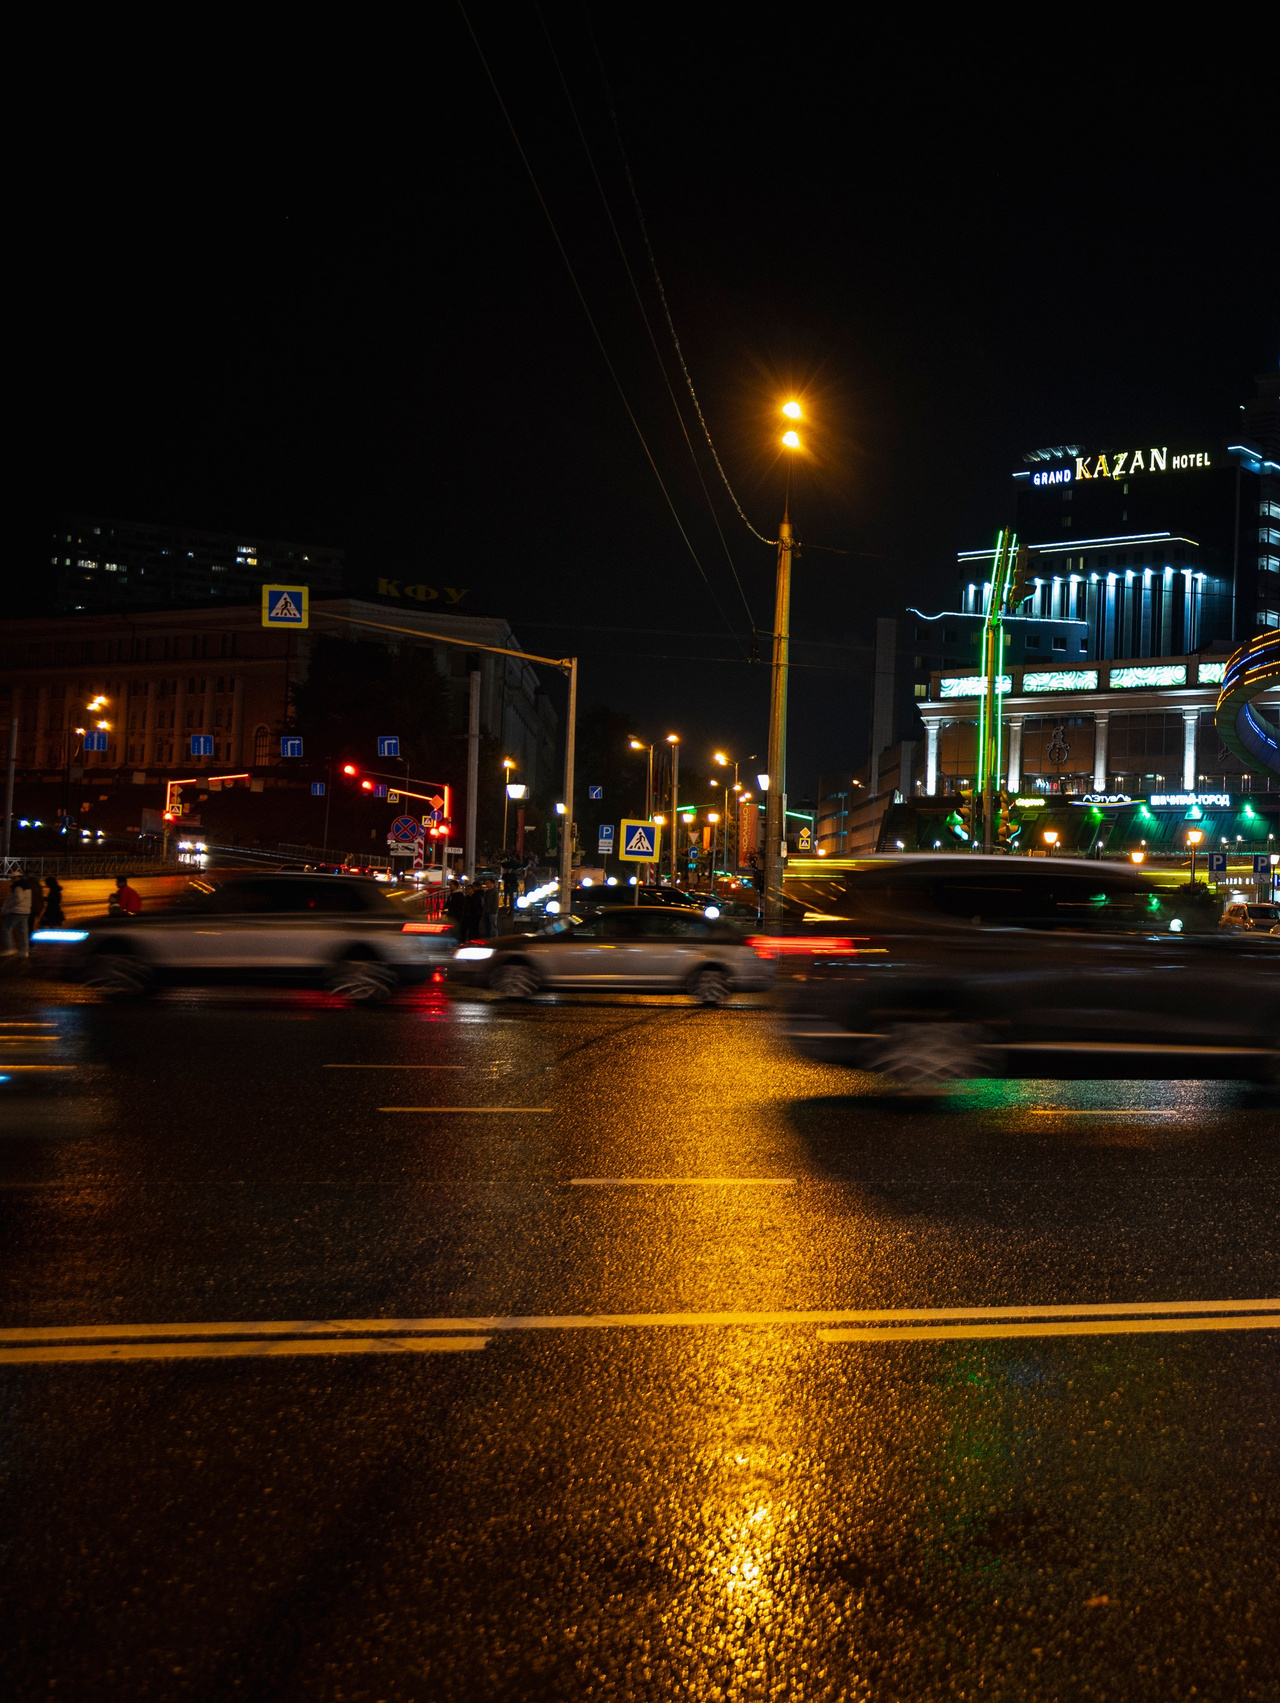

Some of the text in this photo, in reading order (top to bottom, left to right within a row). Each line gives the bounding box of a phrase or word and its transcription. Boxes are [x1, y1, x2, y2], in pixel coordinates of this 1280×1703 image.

[1033, 446, 1211, 486] GRAND KAZAN HOTEL
[376, 576, 471, 605] КФУ
[1166, 792, 1230, 807] ЧИТАЙ-ГОРОД
[1213, 855, 1224, 870] P
[1257, 857, 1268, 872] P
